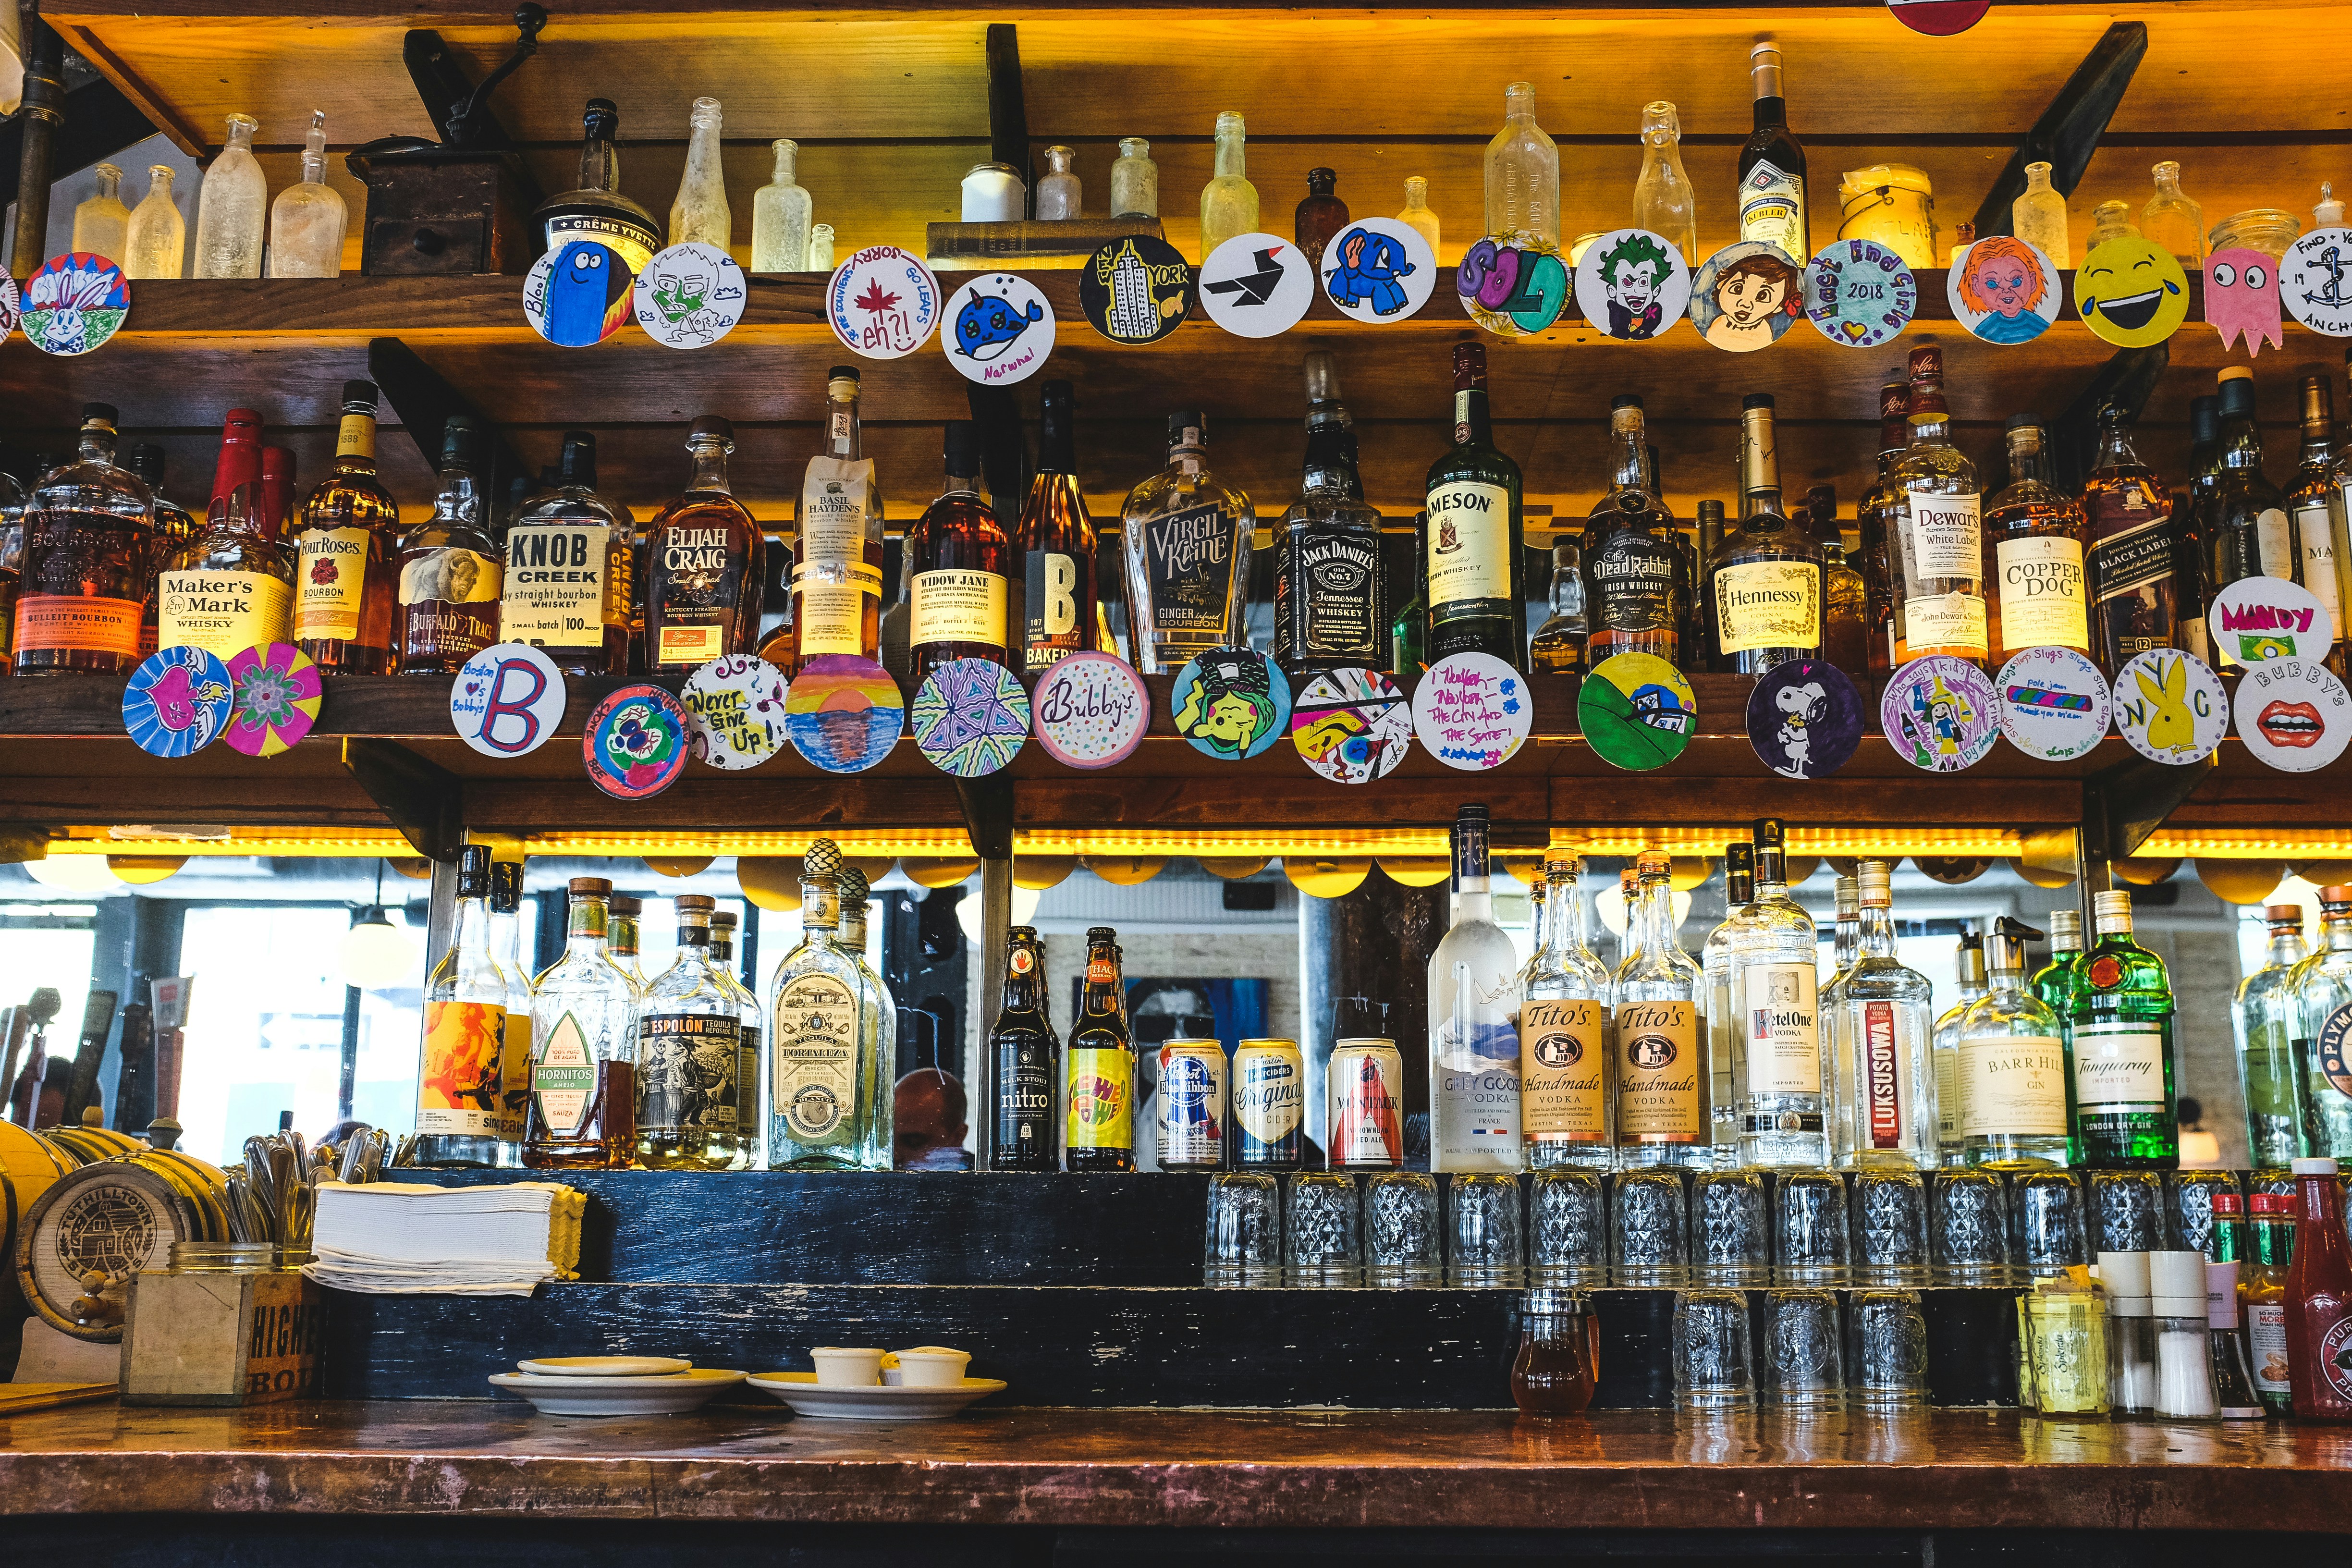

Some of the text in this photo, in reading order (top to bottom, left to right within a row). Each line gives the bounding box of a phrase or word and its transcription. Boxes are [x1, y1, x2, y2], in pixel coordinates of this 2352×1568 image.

[1748, 208, 1784, 222] KÜBLER
[622, 226, 657, 251] YVETTE
[2296, 236, 2326, 255] FIND
[851, 246, 901, 270] SORRY
[1096, 245, 1112, 286] NEW
[1148, 265, 1189, 286] YORK
[1850, 240, 1902, 272] End
[1882, 272, 1917, 329] Girls
[2294, 273, 2304, 285] 19
[836, 269, 854, 313] SOUVIENS
[1458, 239, 1566, 332] SOLD
[1847, 282, 1884, 299] 2018
[906, 267, 929, 325] GO LEAFS
[2303, 313, 2352, 332] ANCH
[983, 347, 1035, 380] Narwhal
[808, 505, 860, 514] HAYDEN'S
[820, 496, 850, 505] BASIL
[1426, 492, 1492, 524] AMESON
[1918, 509, 1979, 529] Dewar's
[302, 537, 360, 556] Four Roses
[665, 527, 729, 551] ELIJAH
[2108, 534, 2158, 555] JOHNNIE WALKER
[511, 533, 588, 568] KNOB
[664, 548, 726, 572] CRAIG
[1302, 540, 1375, 570] JACK DANIEL'S
[1603, 550, 1626, 562] The
[2098, 550, 2137, 570] BLACK
[1443, 565, 1482, 576] WHISKEY
[1594, 554, 1672, 580] Dead Rabbit
[2007, 562, 2082, 584] COPPER
[166, 579, 253, 594] Maker's
[518, 571, 598, 584] CREEK
[610, 552, 621, 621] CREEK
[667, 572, 695, 585] Small
[921, 575, 989, 588] WIDOW JANE
[1605, 581, 1663, 592] IRISH WHISKEY
[2025, 577, 2073, 597] DOG
[304, 588, 344, 598] BOURBON
[513, 589, 597, 601] straight bourbon
[1044, 553, 1076, 635] B
[1316, 590, 1364, 603] Tennessee
[1439, 592, 1462, 601] IMPORTED
[1730, 589, 1804, 610] Hennessy
[186, 597, 251, 613] Mark
[1317, 608, 1363, 617] WHISKEY
[28, 613, 122, 624] BULLEIT BOURBON
[413, 612, 493, 640] BUFFALO TRACE
[537, 620, 559, 630] batch
[566, 618, 585, 630] 100
[1159, 608, 1222, 626] GINGER infused
[1159, 619, 1219, 628] BOURBON
[1921, 612, 1963, 623] John Dewar
[2220, 602, 2315, 633] MANDY
[437, 634, 471, 643] KENTUCKY
[2034, 649, 2063, 664] Slugs
[2068, 652, 2092, 673] Slugs
[463, 662, 494, 679] Boston
[1999, 663, 2016, 686] Slugs
[1887, 682, 1909, 700] Who
[1908, 665, 1929, 683] says
[1939, 658, 1965, 675] kids
[1970, 669, 1992, 693] can't
[1986, 692, 2001, 728] drink
[2027, 679, 2045, 688] pole
[2094, 674, 2108, 700] Slugs
[471, 656, 548, 753] B
[648, 688, 683, 720] NATHAN
[686, 689, 741, 711] Never
[1041, 677, 1134, 728] Bubby's
[2013, 705, 2054, 719] thank you
[2095, 705, 2109, 732] Slugs
[710, 713, 747, 732] Give
[2002, 716, 2018, 738] Slugs
[1962, 748, 1980, 761] by
[587, 757, 608, 780] BEE
[705, 1019, 731, 1029] TEQUILA
[1528, 1002, 1591, 1029] Tito's
[1622, 1004, 1684, 1030] Tito's
[1753, 1009, 1812, 1040] Ketel One
[797, 1036, 835, 1045] TEQUILA
[782, 1049, 849, 1057] FORTALEZA
[538, 1069, 593, 1080] HORNITOS
[1173, 1063, 1201, 1081] Pabst
[1989, 1057, 2034, 1073] BARR
[2079, 1058, 2153, 1076] Tanqueray
[1001, 1075, 1048, 1085] MILK STOUT
[1444, 1077, 1478, 1091] GREY
[1524, 1073, 1600, 1093] Handmade
[1620, 1074, 1694, 1093] Handmade
[1874, 1022, 1896, 1129] LUKSUSOWA
[2092, 1076, 2131, 1084] IMPORTED
[1181, 1080, 1216, 1093] Ribbon
[1235, 1077, 1304, 1112] Original
[2027, 1081, 2045, 1090] GIN
[1001, 1086, 1048, 1109] nitro
[1336, 1096, 1399, 1110] MONTAUK
[1466, 1093, 1510, 1104] VODKA
[1539, 1095, 1581, 1104] VODKA
[1633, 1097, 1676, 1105] VODKA
[791, 1107, 815, 1132] ELABORADO
[1266, 1114, 1291, 1125] CIDER
[2086, 1122, 2115, 1131] LONDON
[61, 1187, 153, 1231] TUTHILLTOWN
[2036, 1335, 2048, 1375] Splenda
[2057, 1334, 2069, 1373] Splenda
